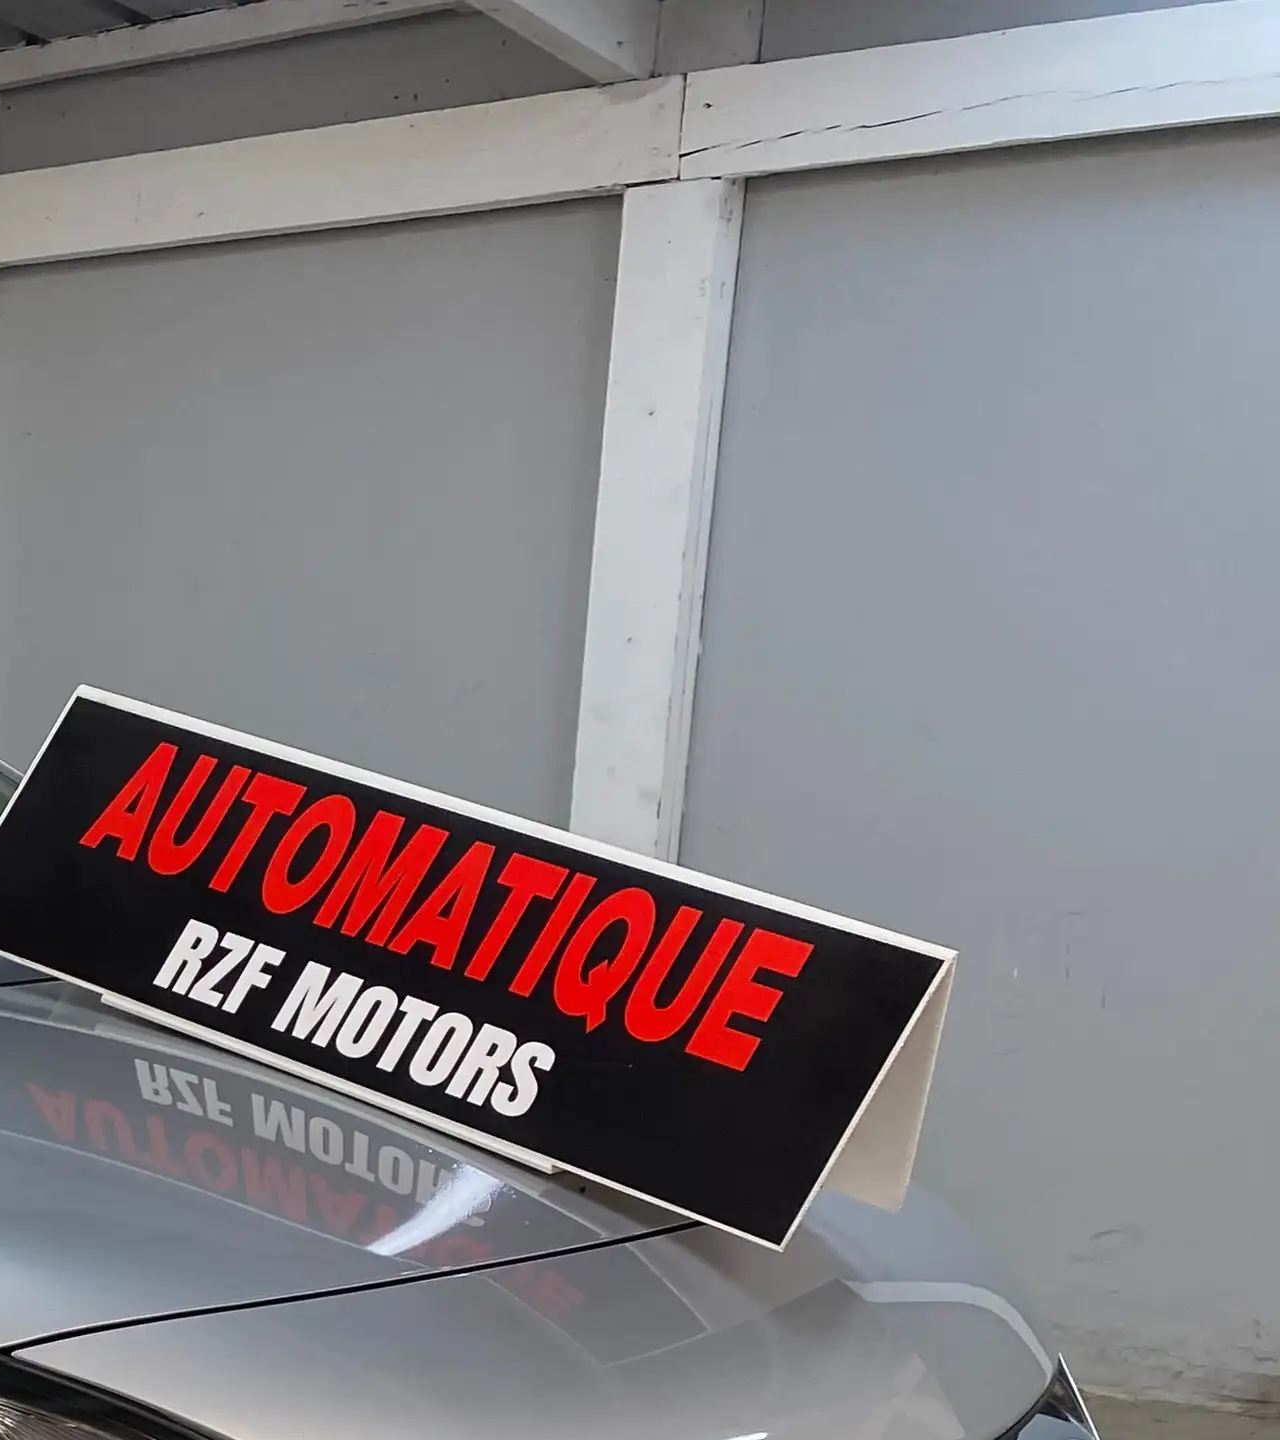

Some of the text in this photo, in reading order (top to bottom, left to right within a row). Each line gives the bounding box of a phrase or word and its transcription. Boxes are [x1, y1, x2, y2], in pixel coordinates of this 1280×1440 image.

[79, 740, 815, 1072] AUTOMATIQUE
[153, 919, 556, 1117] RZF MOTORS
